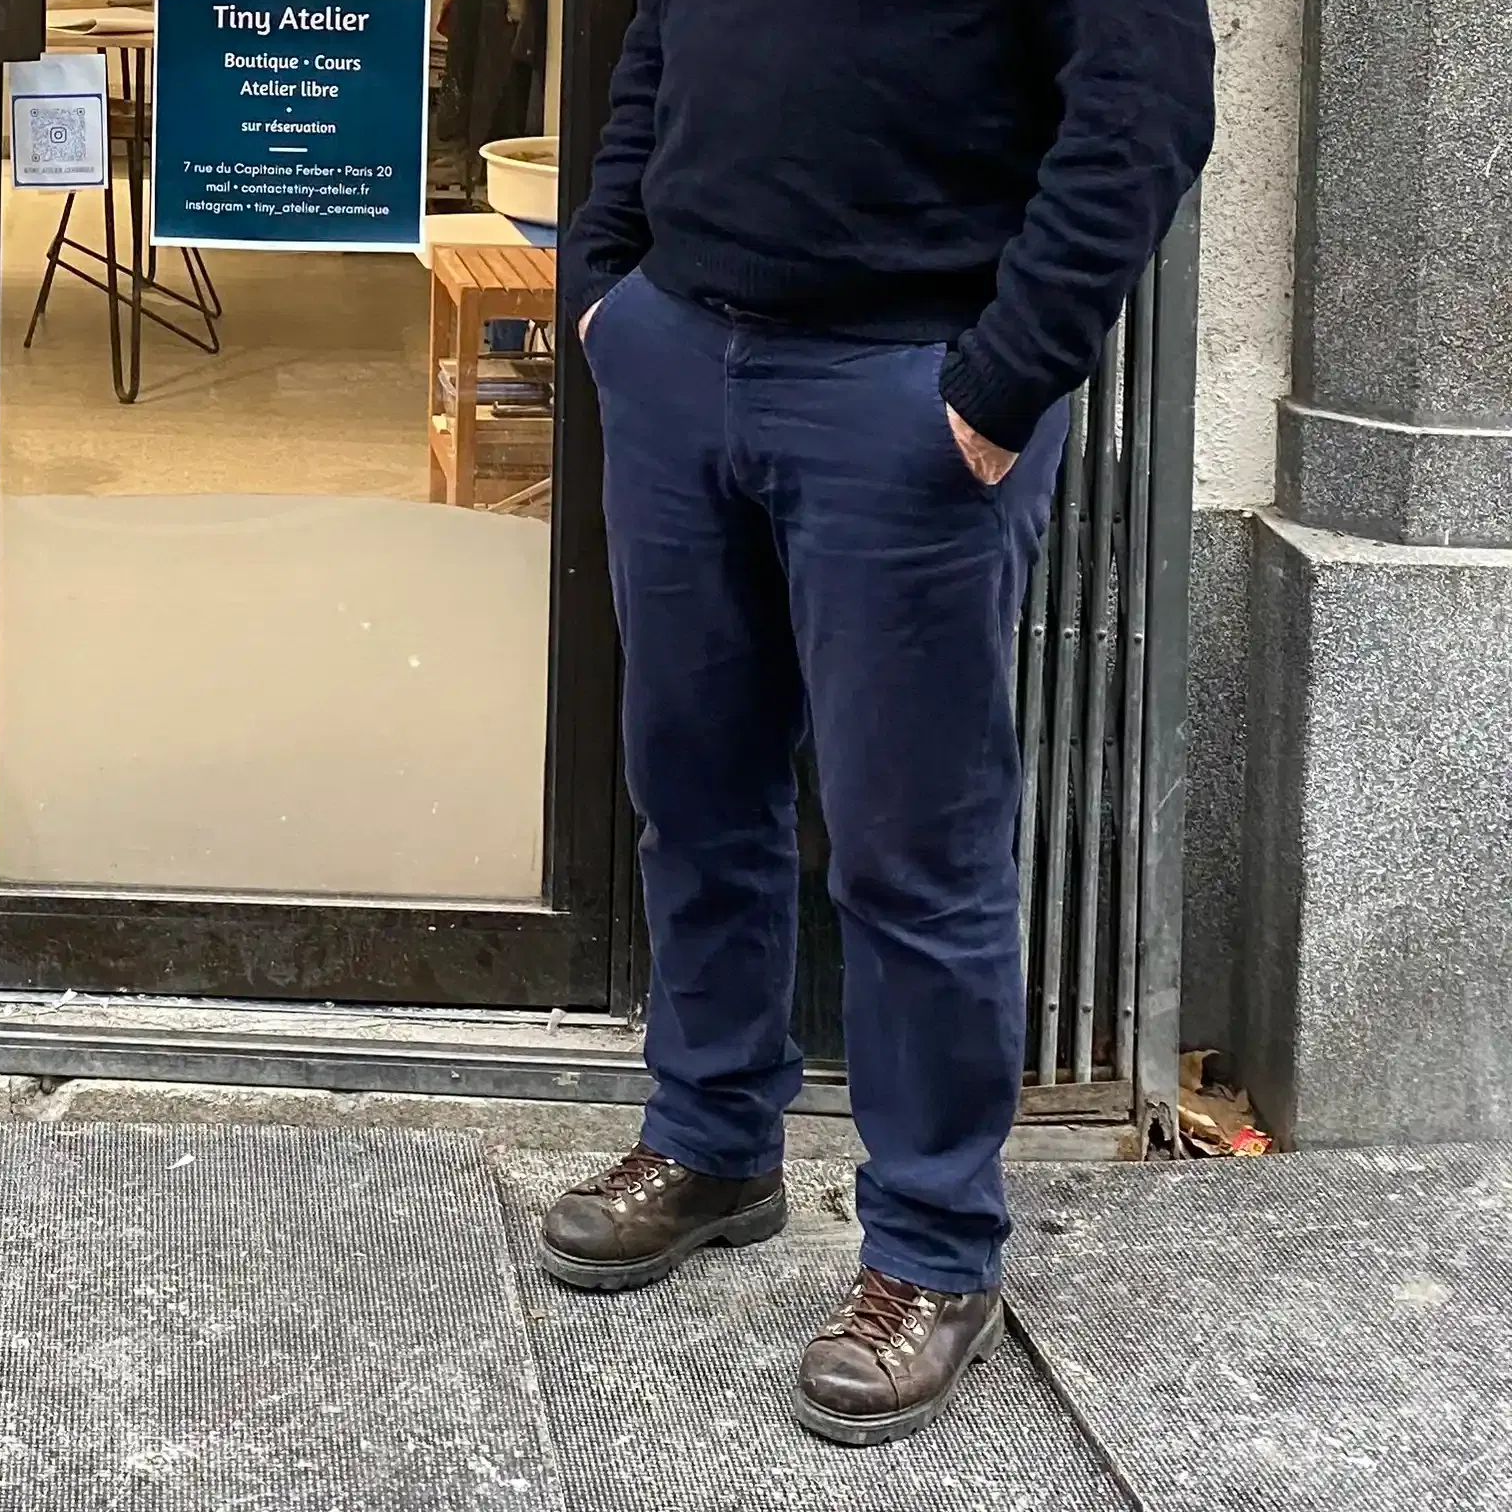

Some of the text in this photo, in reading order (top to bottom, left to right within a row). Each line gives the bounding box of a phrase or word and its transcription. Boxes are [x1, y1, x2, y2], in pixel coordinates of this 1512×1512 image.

[213, 4, 370, 36] Tiny Atelier
[224, 52, 361, 72] Boutique Cours
[240, 80, 339, 98] Atelier libre
[241, 119, 336, 134] sur réservation
[183, 161, 393, 178] 7 rue du Capitaine Ferber Paris 20
[206, 181, 230, 193] mail
[185, 199, 390, 218] instagram tiny_atelier_ceramique
